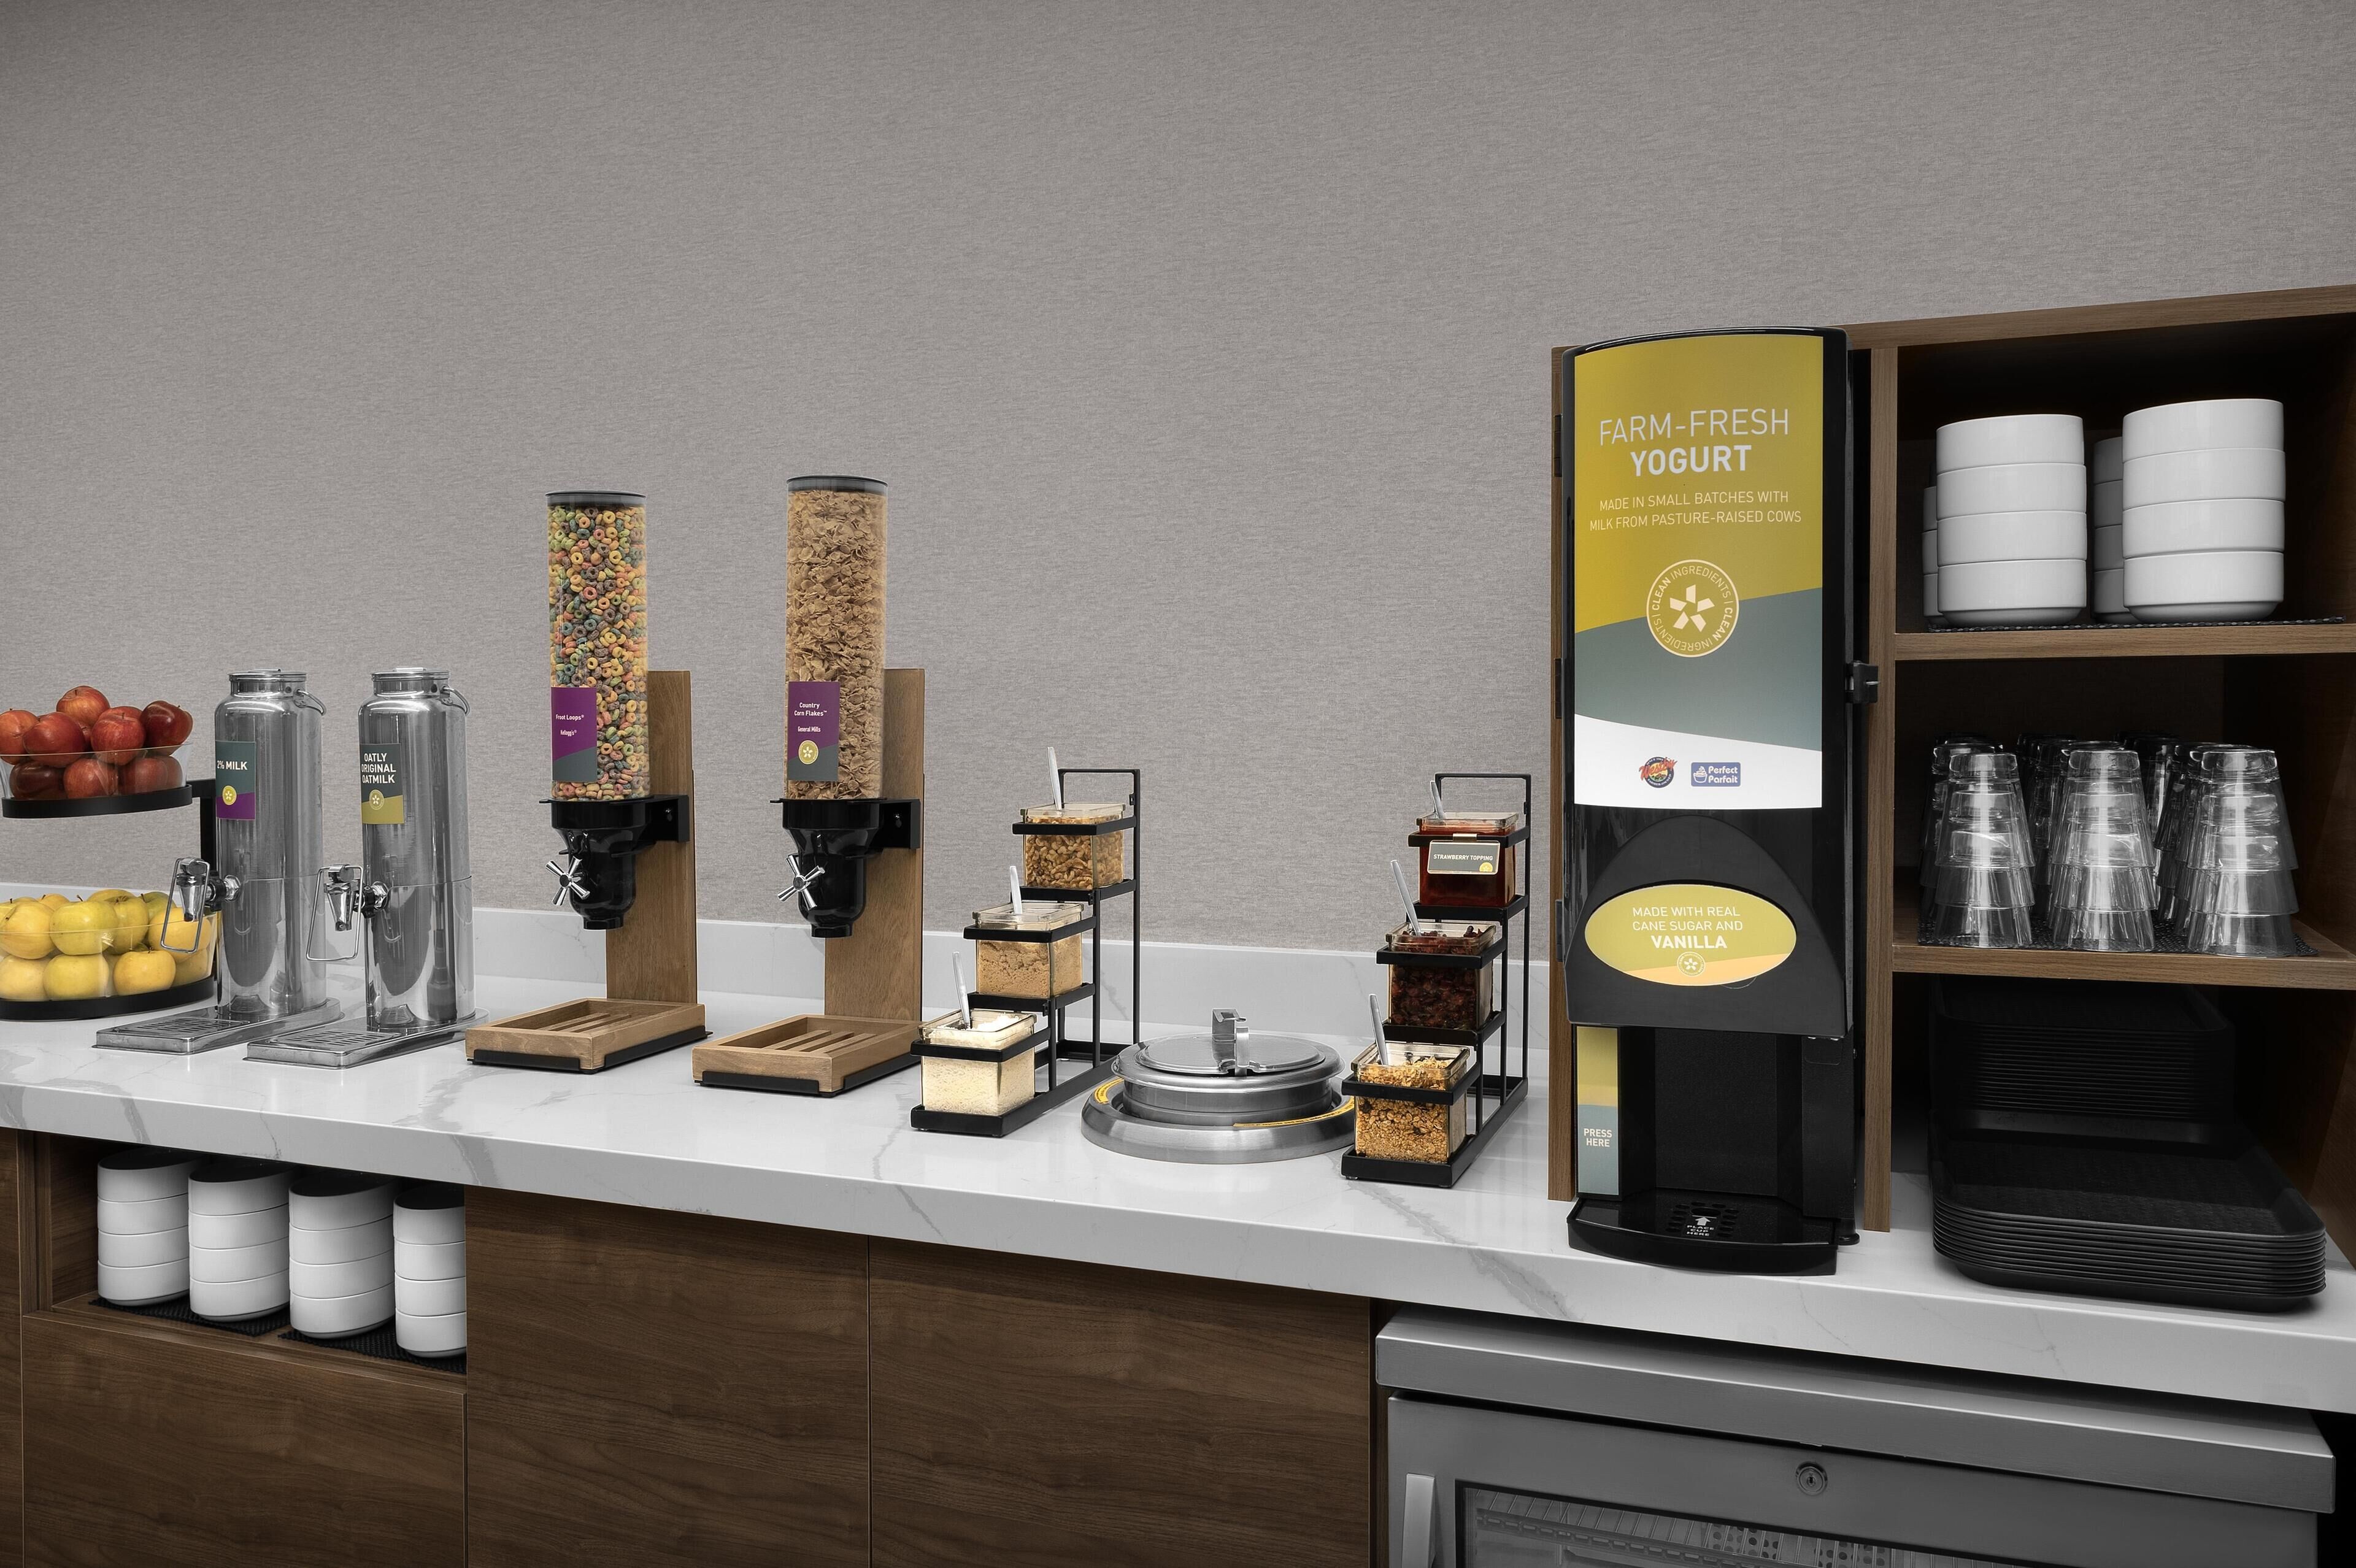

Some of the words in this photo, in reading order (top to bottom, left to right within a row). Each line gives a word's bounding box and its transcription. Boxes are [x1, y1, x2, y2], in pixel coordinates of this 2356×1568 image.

[1600, 408, 1789, 446] FARM-FRESH
[1630, 445, 1752, 477] YOGURT
[1600, 497, 1629, 511] MADE
[1633, 496, 1644, 508] IN
[1648, 493, 1690, 507] SMALL
[1695, 491, 1754, 504] BATCHES
[1758, 491, 1788, 502] WITH
[1590, 519, 1613, 531] MILK
[1615, 515, 1648, 528] FROM
[1652, 510, 1763, 526] PASTURE-RAISED
[1767, 510, 1802, 523] COWS
[1652, 577, 1671, 610] CLEAN
[1671, 565, 1731, 598] INGREDIENTS
[1712, 607, 1733, 641] CLEAN
[1653, 618, 1713, 651] INGREDIENTS
[364, 753, 387, 761] OATLY
[226, 761, 248, 770] MILK
[361, 764, 396, 773] ORIGINAL
[362, 774, 395, 783] OATMILK
[1708, 775, 1738, 783] Parfait
[1632, 907, 1668, 917] MADE
[1671, 907, 1703, 917] WITH
[1707, 907, 1740, 917] REAL
[1632, 921, 1667, 931] CANE
[1669, 921, 1712, 931] SUGAR
[1715, 921, 1743, 931] AND
[1650, 935, 1728, 949] VANILLA
[1584, 1128, 1612, 1138] PRESS
[1586, 1138, 1610, 1148] HERE
